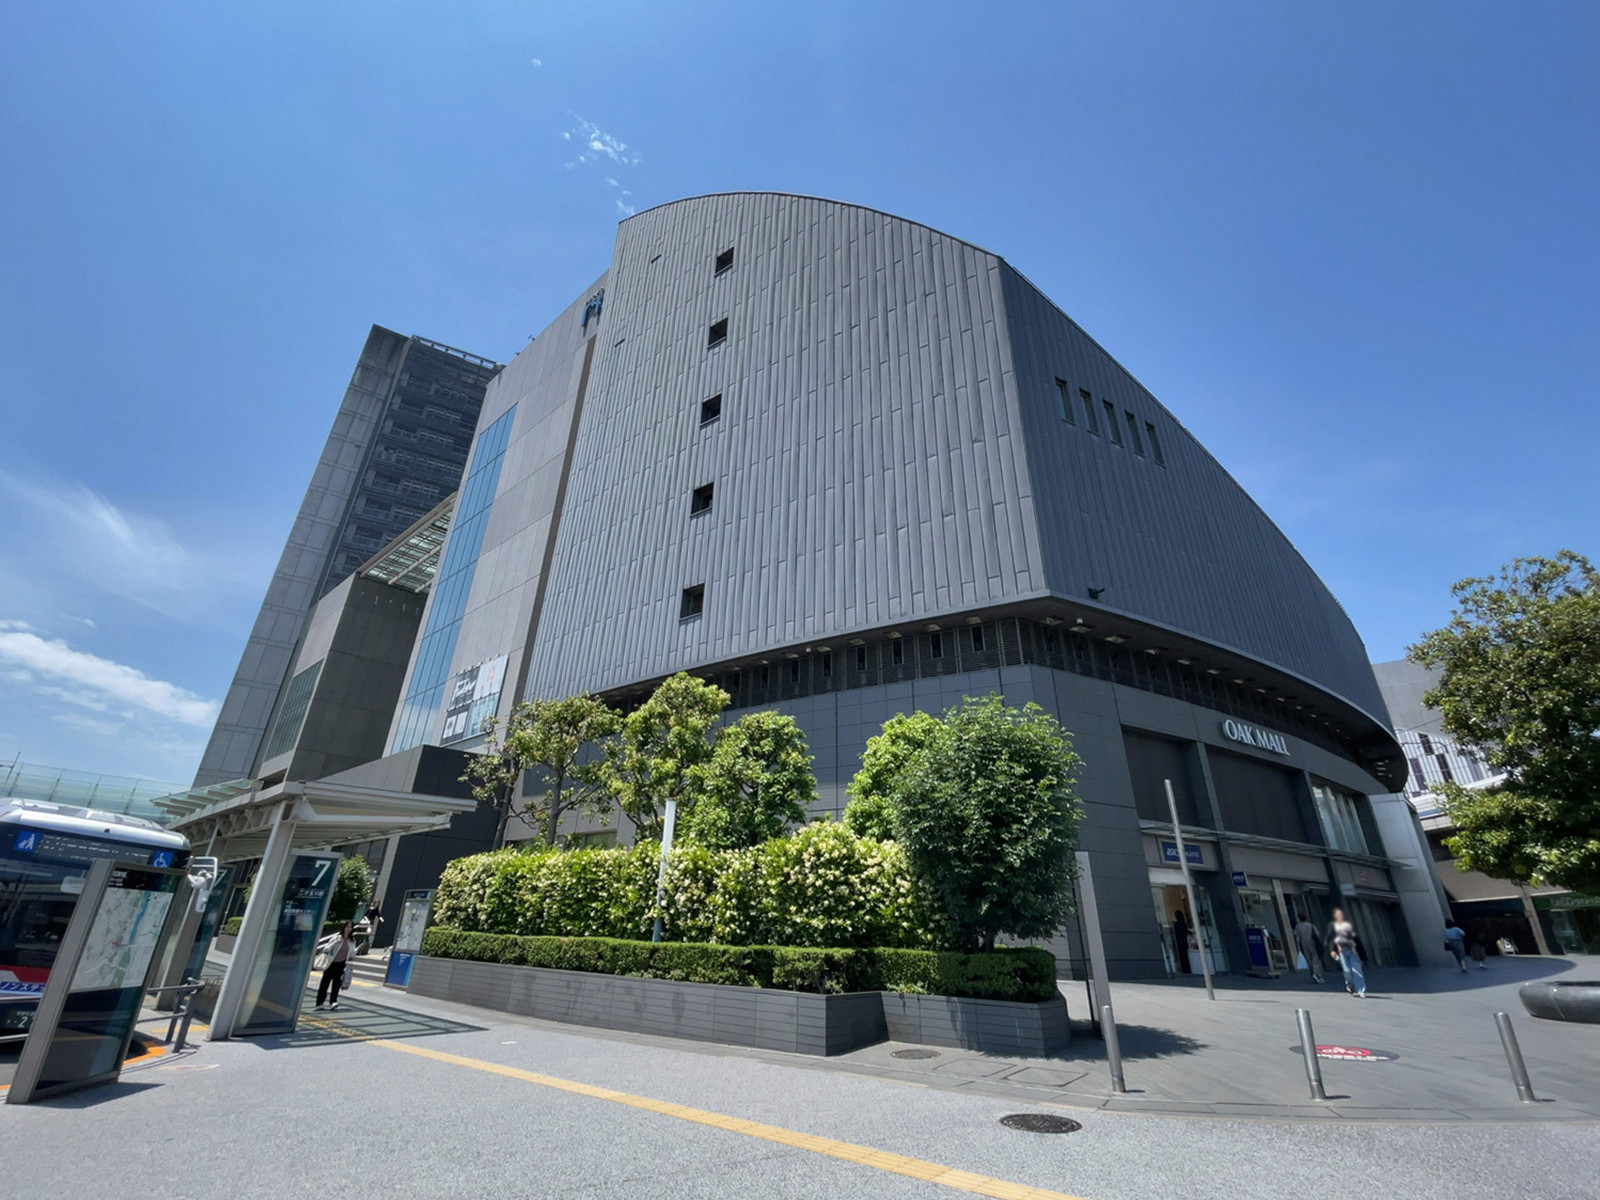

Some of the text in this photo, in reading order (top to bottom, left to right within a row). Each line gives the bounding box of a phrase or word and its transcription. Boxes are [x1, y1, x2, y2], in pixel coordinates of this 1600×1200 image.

[1223, 719, 1291, 756] OAK MALL
[312, 860, 331, 887] 7
